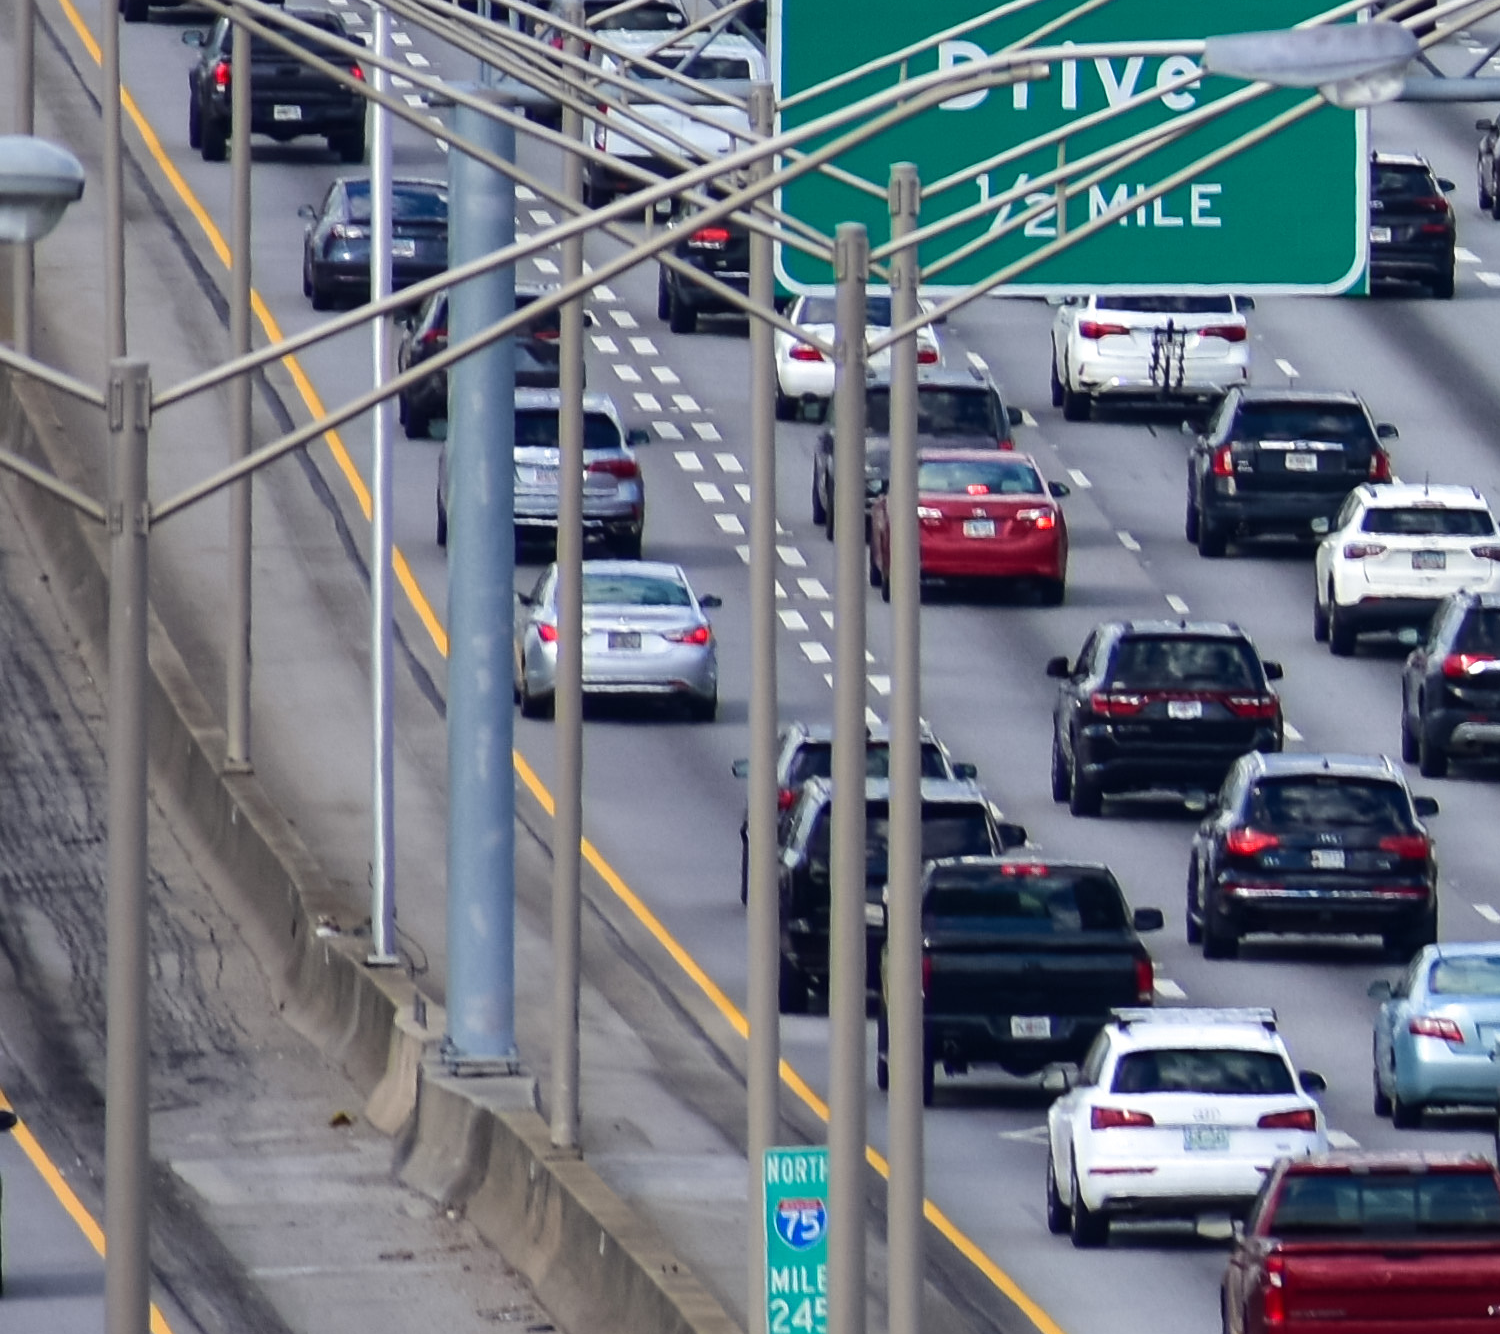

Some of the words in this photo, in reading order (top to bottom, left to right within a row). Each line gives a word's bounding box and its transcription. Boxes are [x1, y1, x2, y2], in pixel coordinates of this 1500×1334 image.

[1087, 183, 1224, 229] MILE
[780, 1208, 820, 1241] 75
[770, 1264, 828, 1296] MILE
